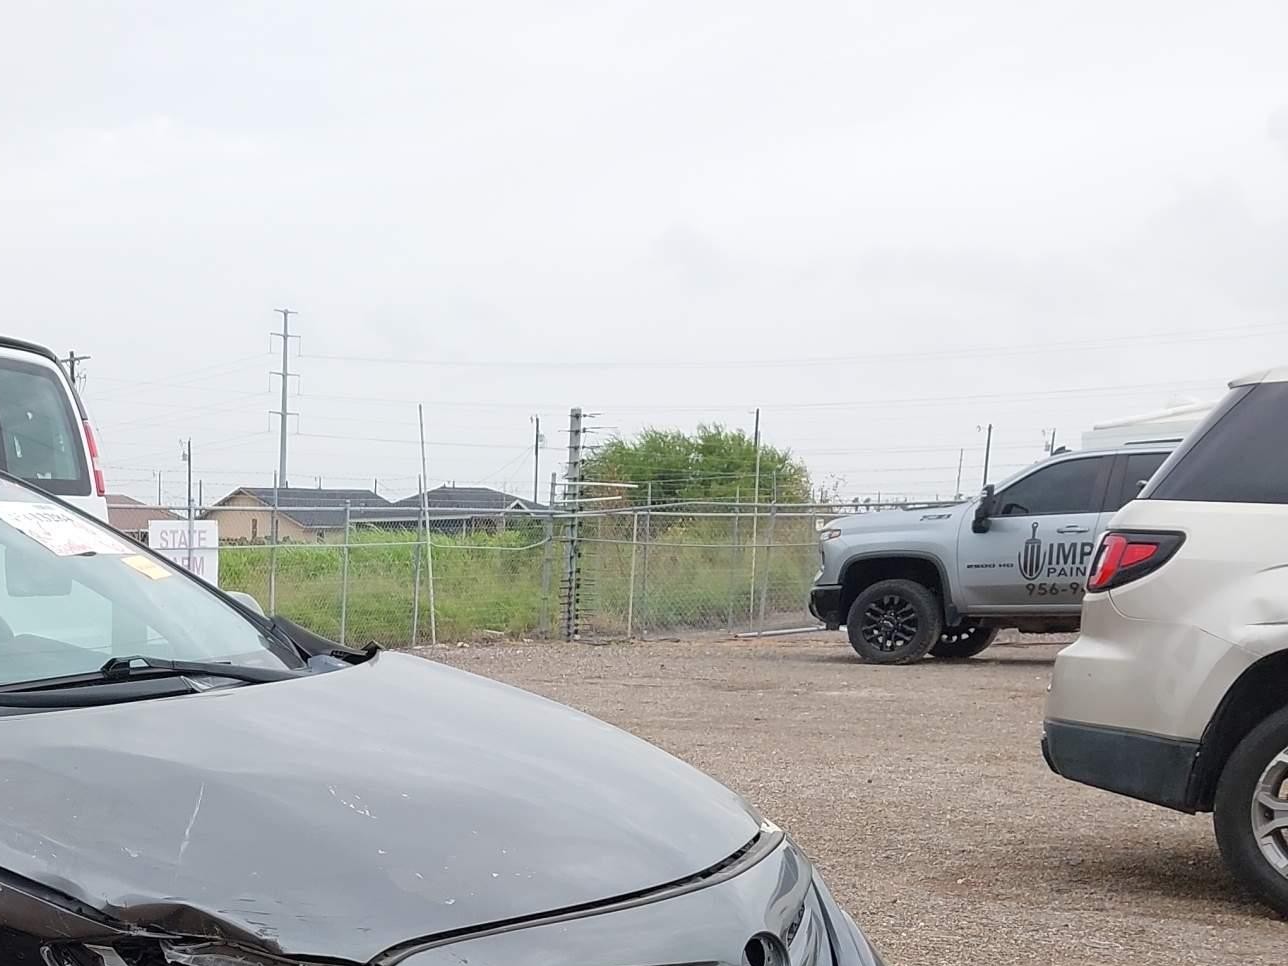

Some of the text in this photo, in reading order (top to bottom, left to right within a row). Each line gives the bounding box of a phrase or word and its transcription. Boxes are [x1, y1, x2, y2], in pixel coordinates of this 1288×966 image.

[159, 529, 207, 549] STATE
[1048, 542, 1094, 565] IMP
[1047, 566, 1087, 577] PAIN
